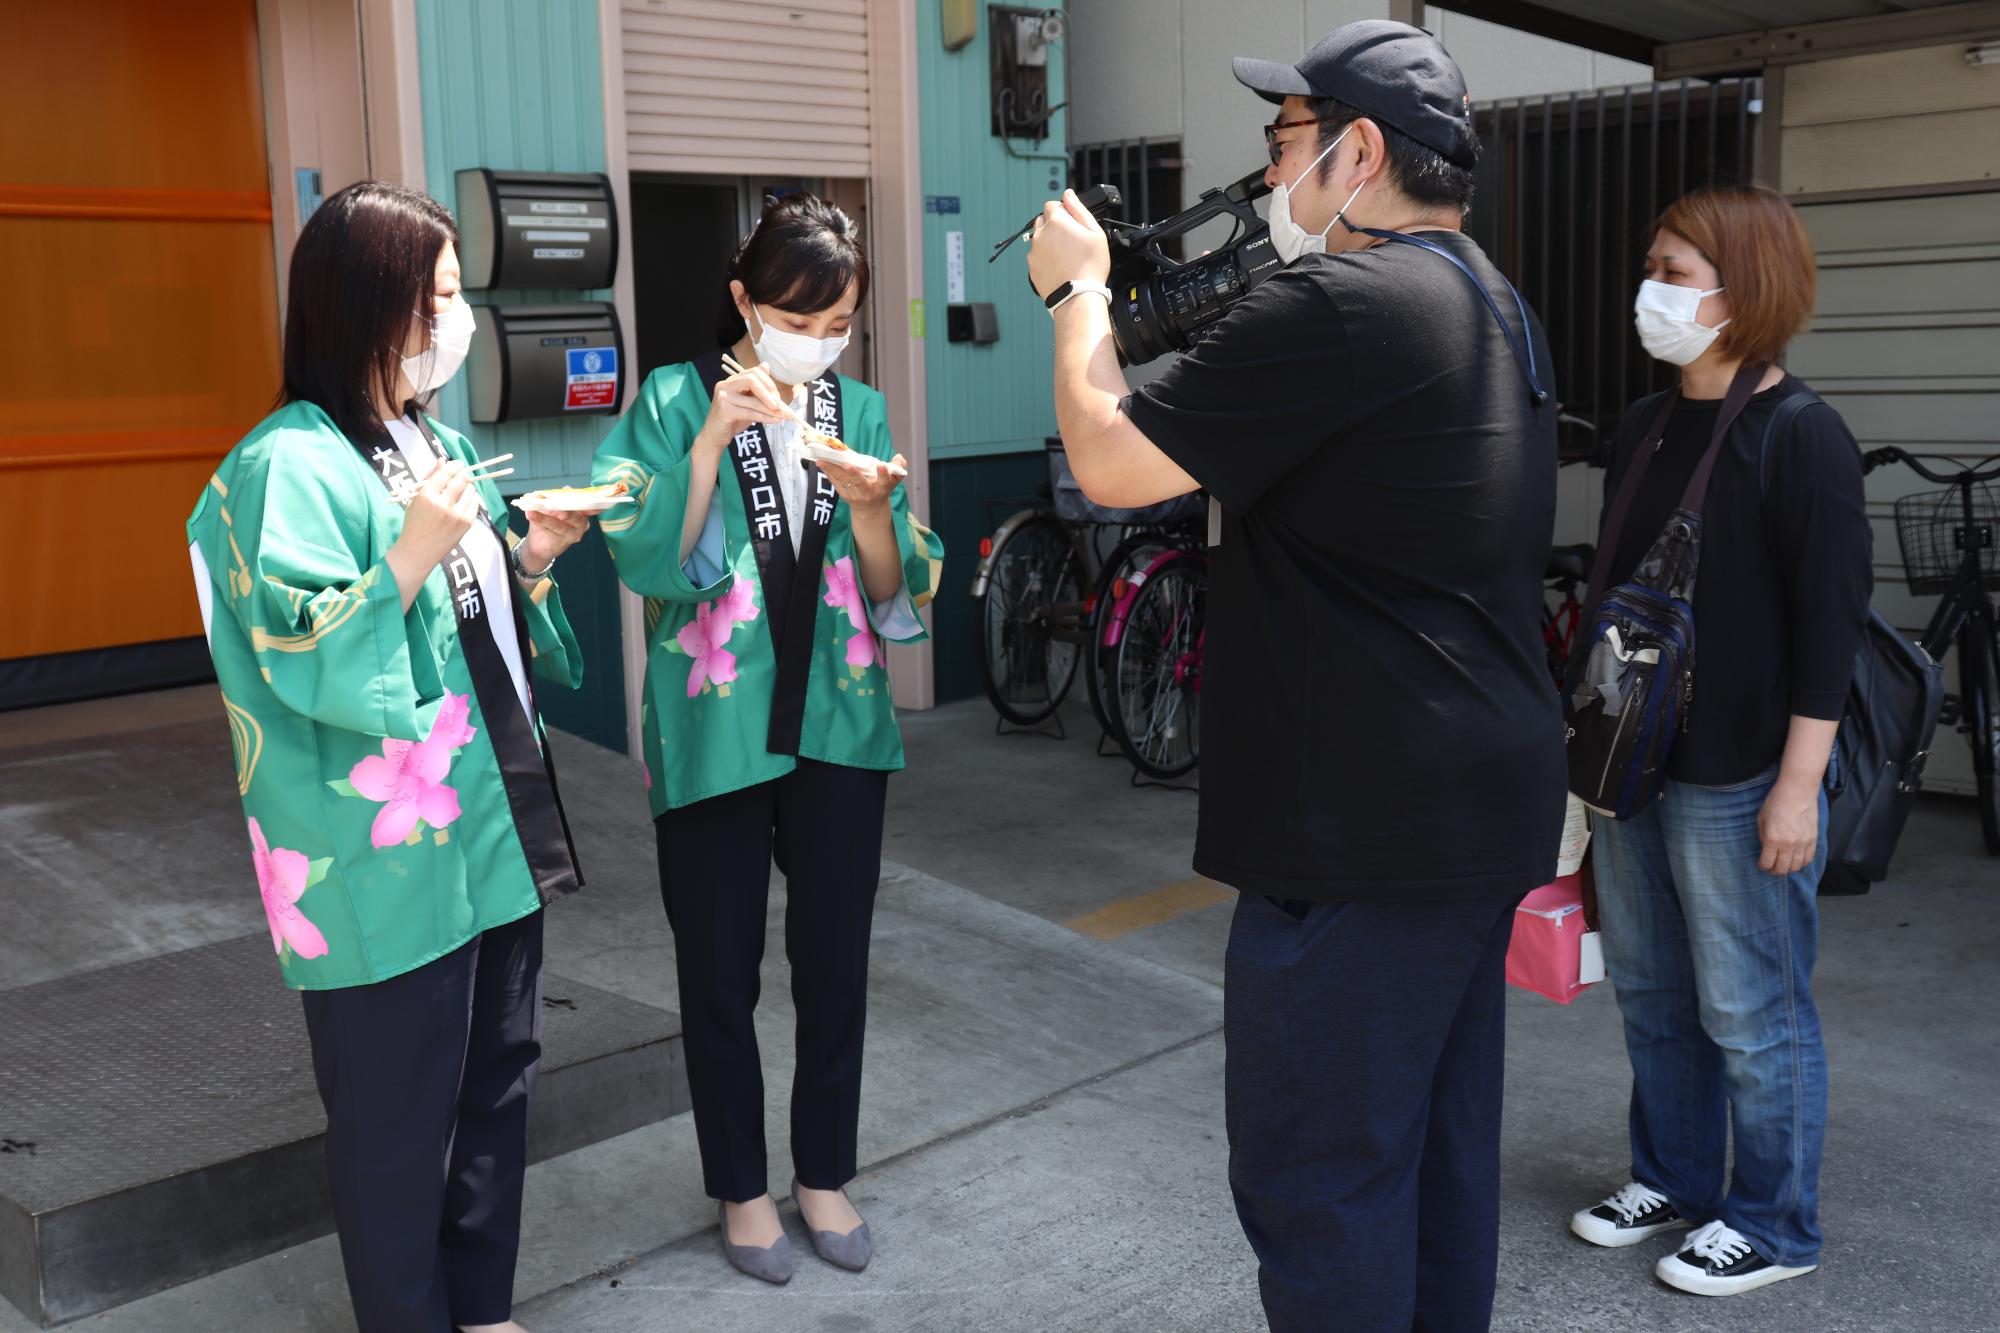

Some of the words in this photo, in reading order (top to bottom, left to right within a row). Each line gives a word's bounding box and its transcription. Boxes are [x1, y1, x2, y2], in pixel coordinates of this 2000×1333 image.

[1246, 237, 1270, 251] SONY
[734, 422, 782, 540] 府守口市
[811, 378, 839, 526] 大阪府口市
